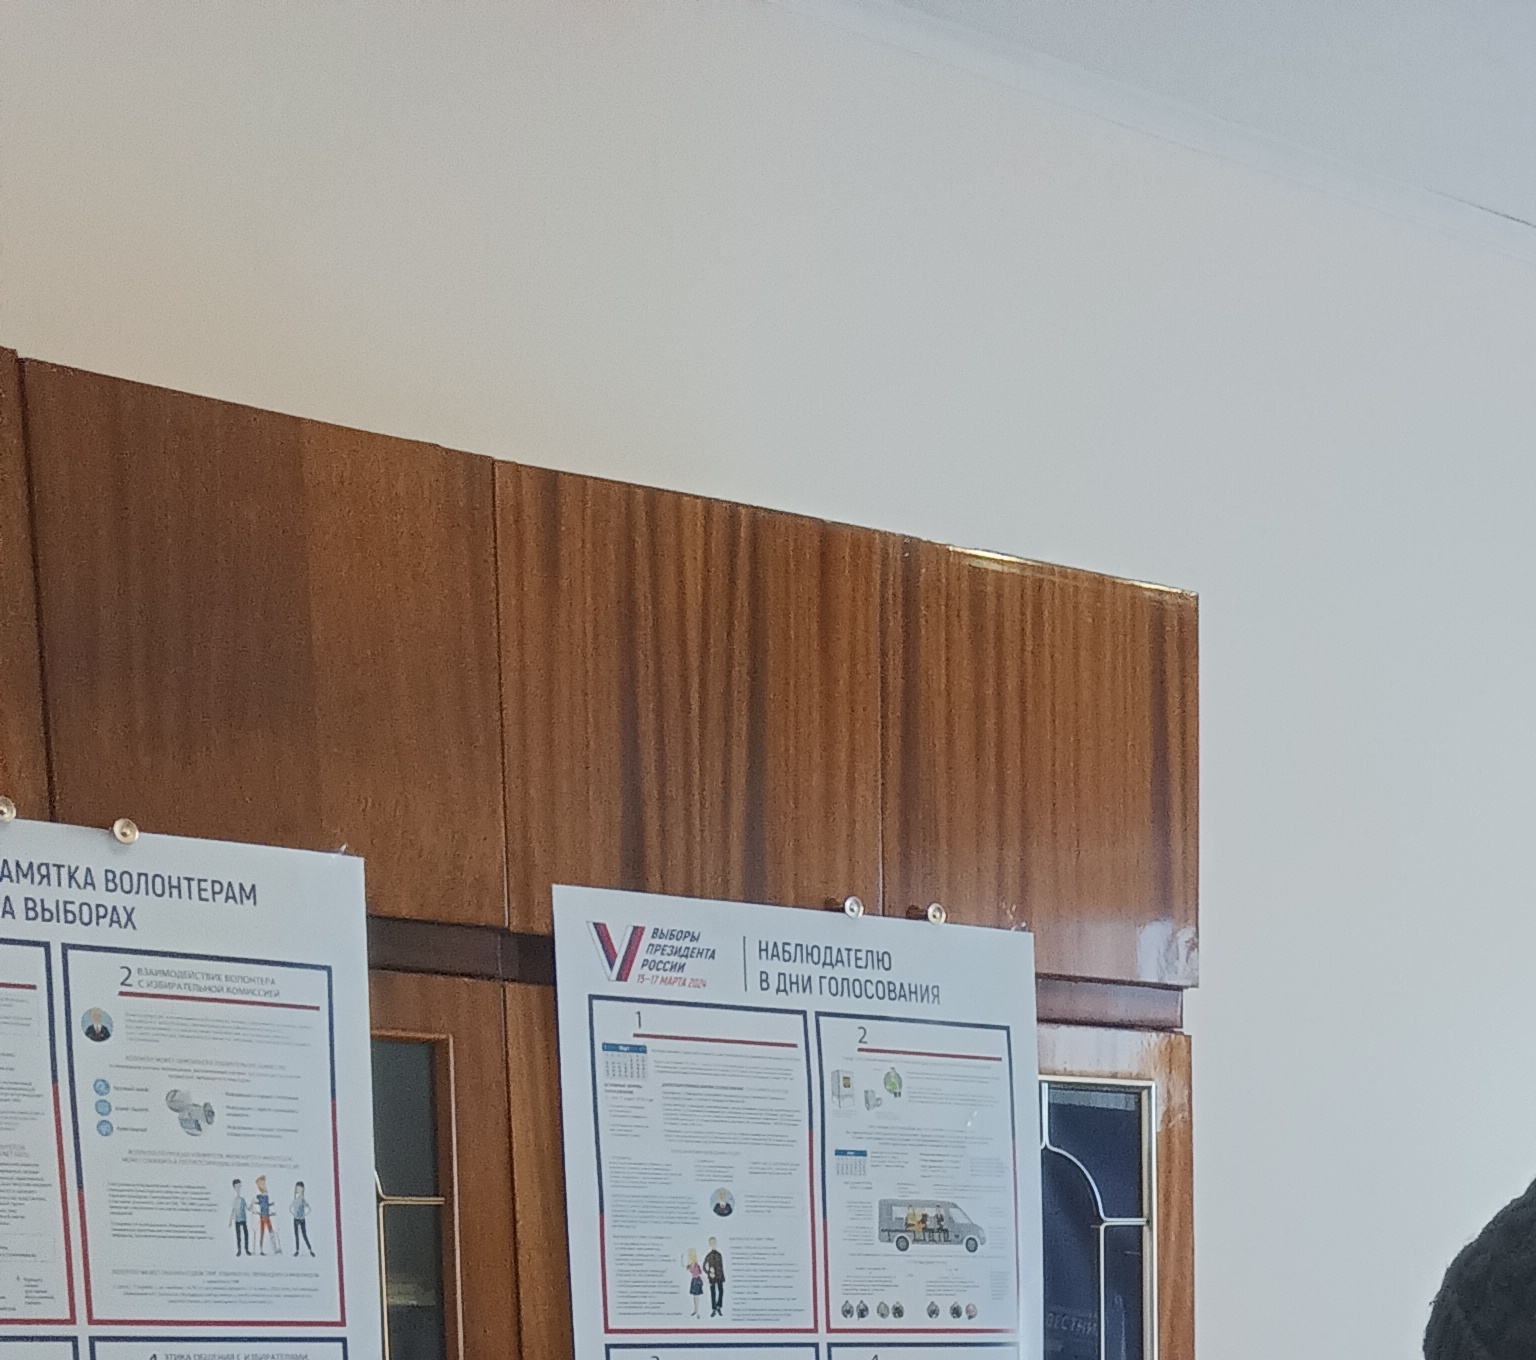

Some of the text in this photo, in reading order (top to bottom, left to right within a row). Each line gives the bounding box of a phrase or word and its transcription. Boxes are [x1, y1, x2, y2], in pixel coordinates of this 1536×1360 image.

[104, 868, 258, 907] ВОЛОНТЕРАМ
[24, 896, 137, 931] ВЫБОРАХ
[651, 927, 701, 942] ВЫБОРЫ
[645, 943, 716, 960] ПРЕЗИДЕНТА
[758, 939, 892, 971] НАБЛЮДАТЕЛЮ
[640, 958, 687, 973] РОССИИ
[119, 966, 133, 987] 2
[660, 975, 687, 987] МАРТА
[759, 971, 941, 1005] В ДНИ ГОЛОСОВАНИЯ
[634, 1011, 642, 1029] 1
[858, 1026, 868, 1044] 2
